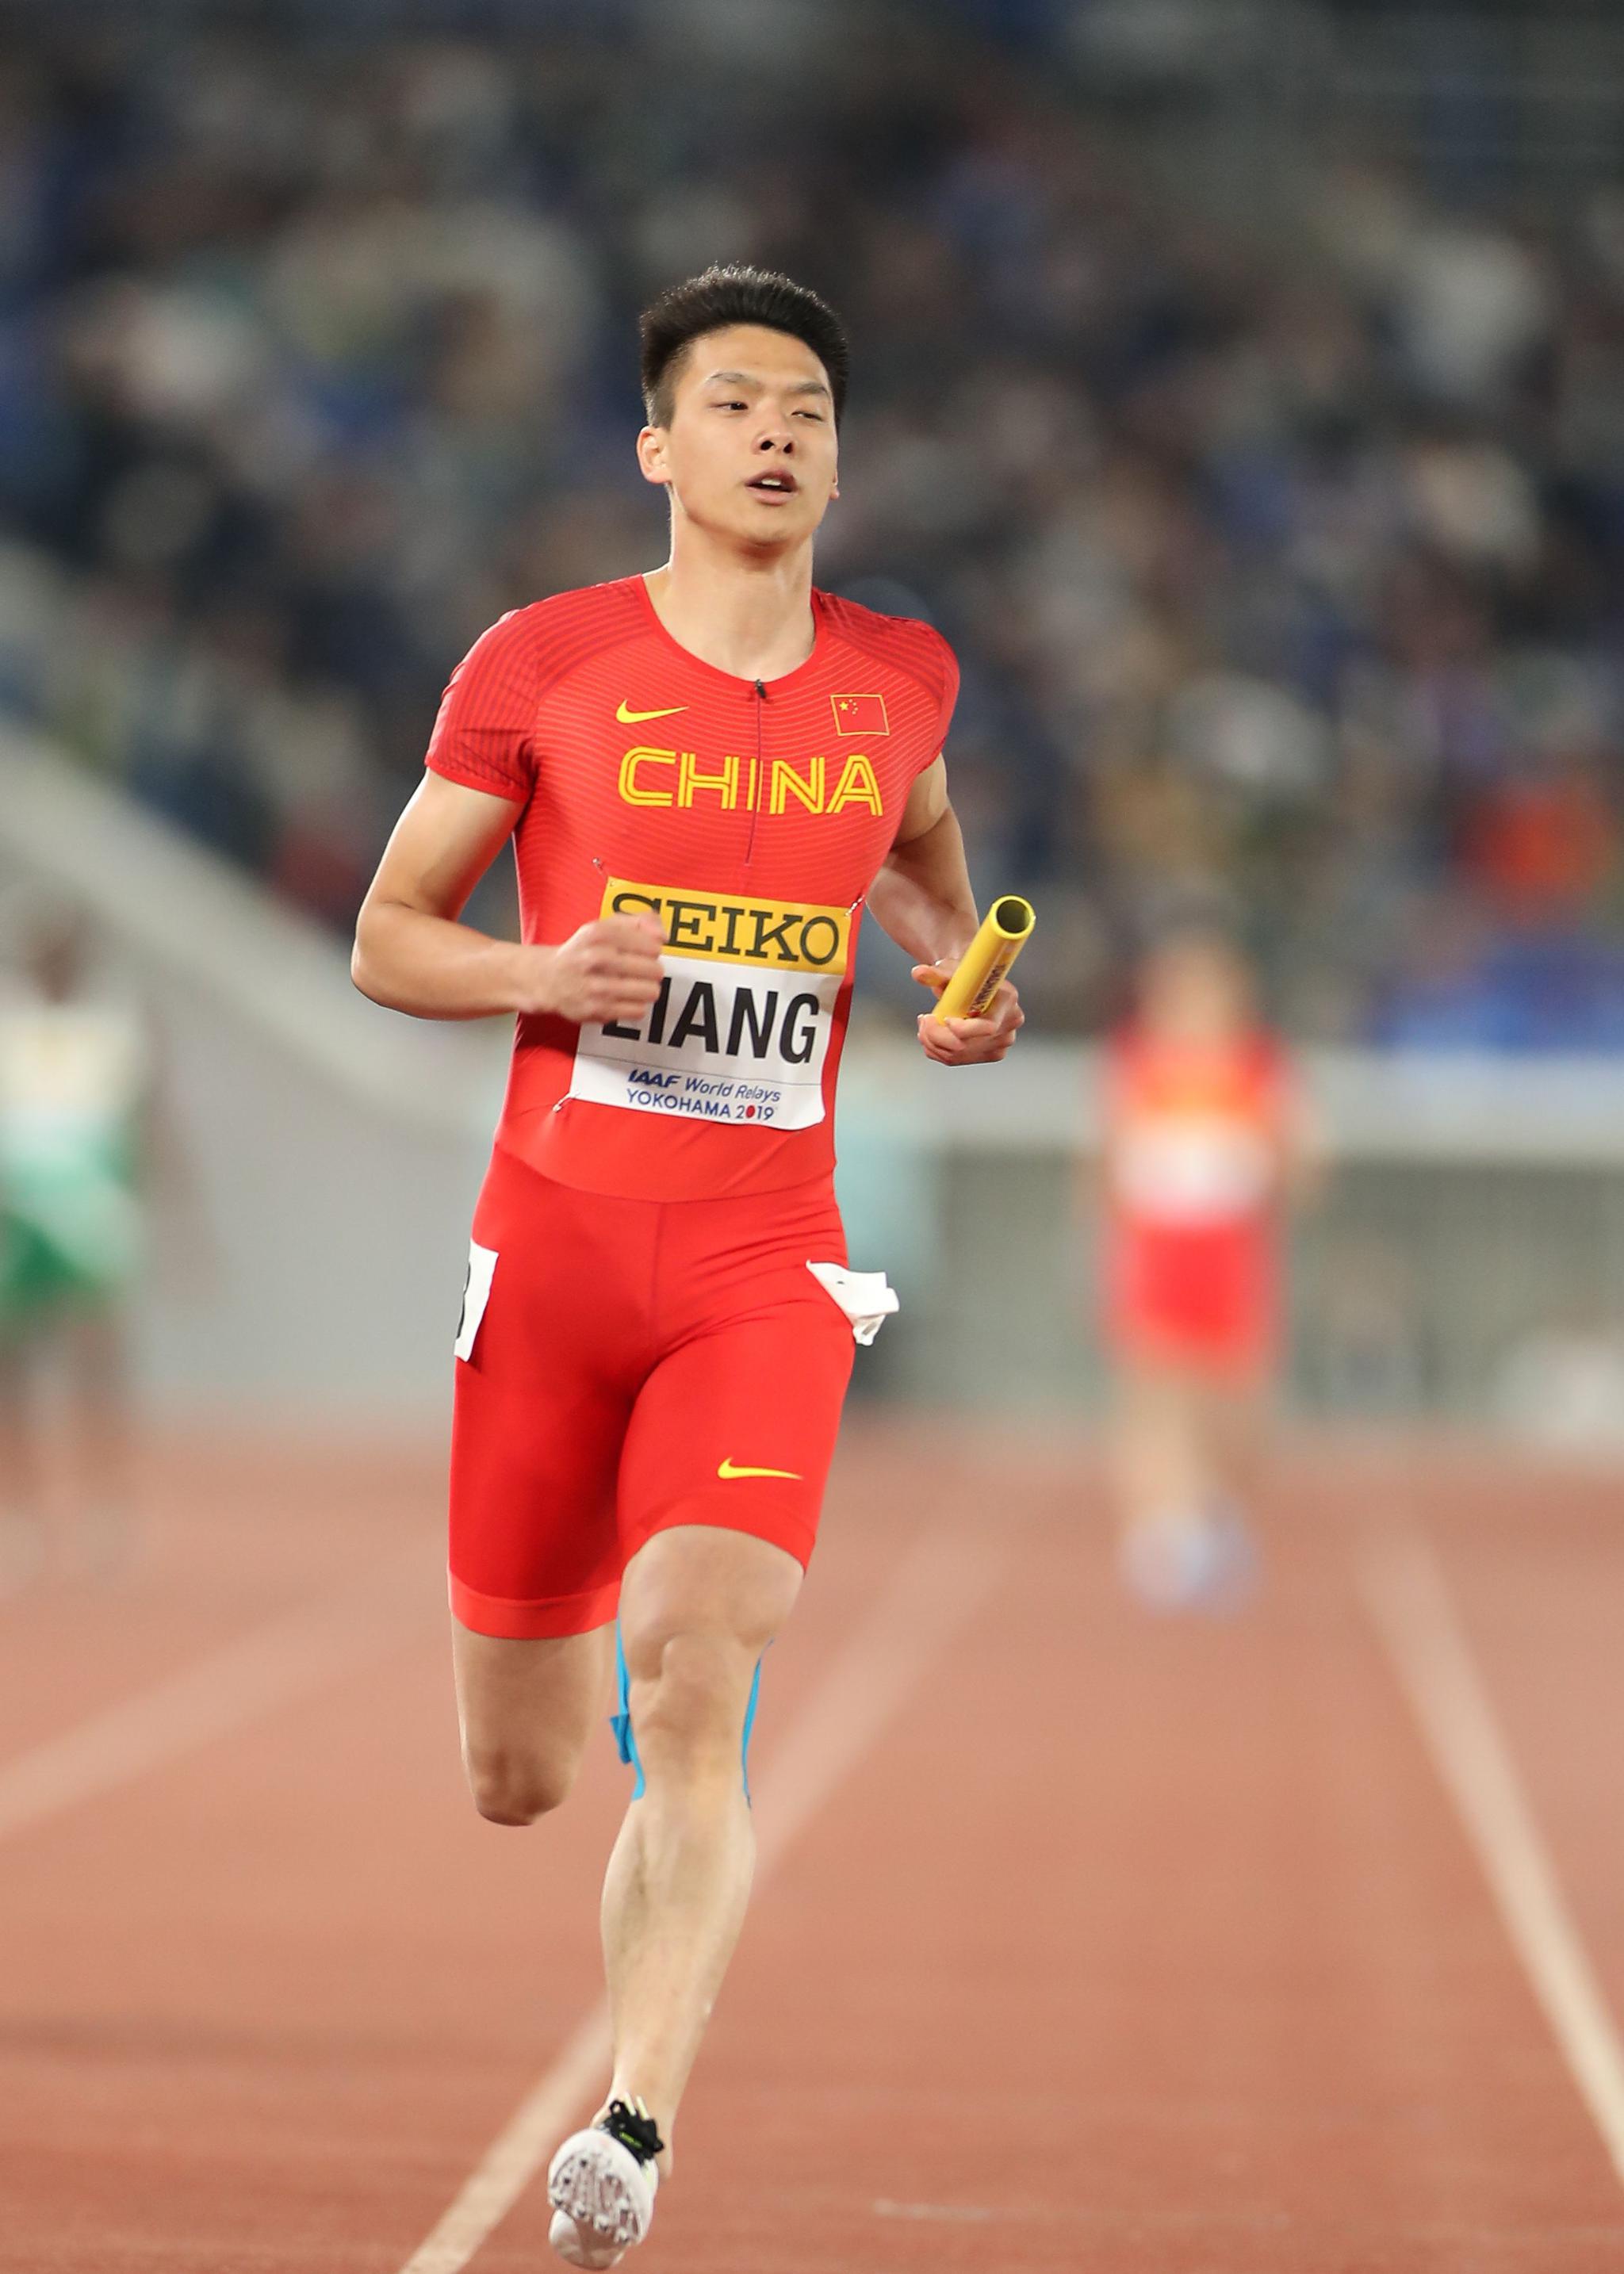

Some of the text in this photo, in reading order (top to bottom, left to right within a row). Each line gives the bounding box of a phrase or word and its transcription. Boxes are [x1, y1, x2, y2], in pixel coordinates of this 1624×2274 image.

[619, 746, 883, 817] CHINA
[602, 976, 820, 1065] IANG
[626, 1089, 775, 1120] YOKOHAMA 2019
[628, 1070, 782, 1104] IAAF World Relays
